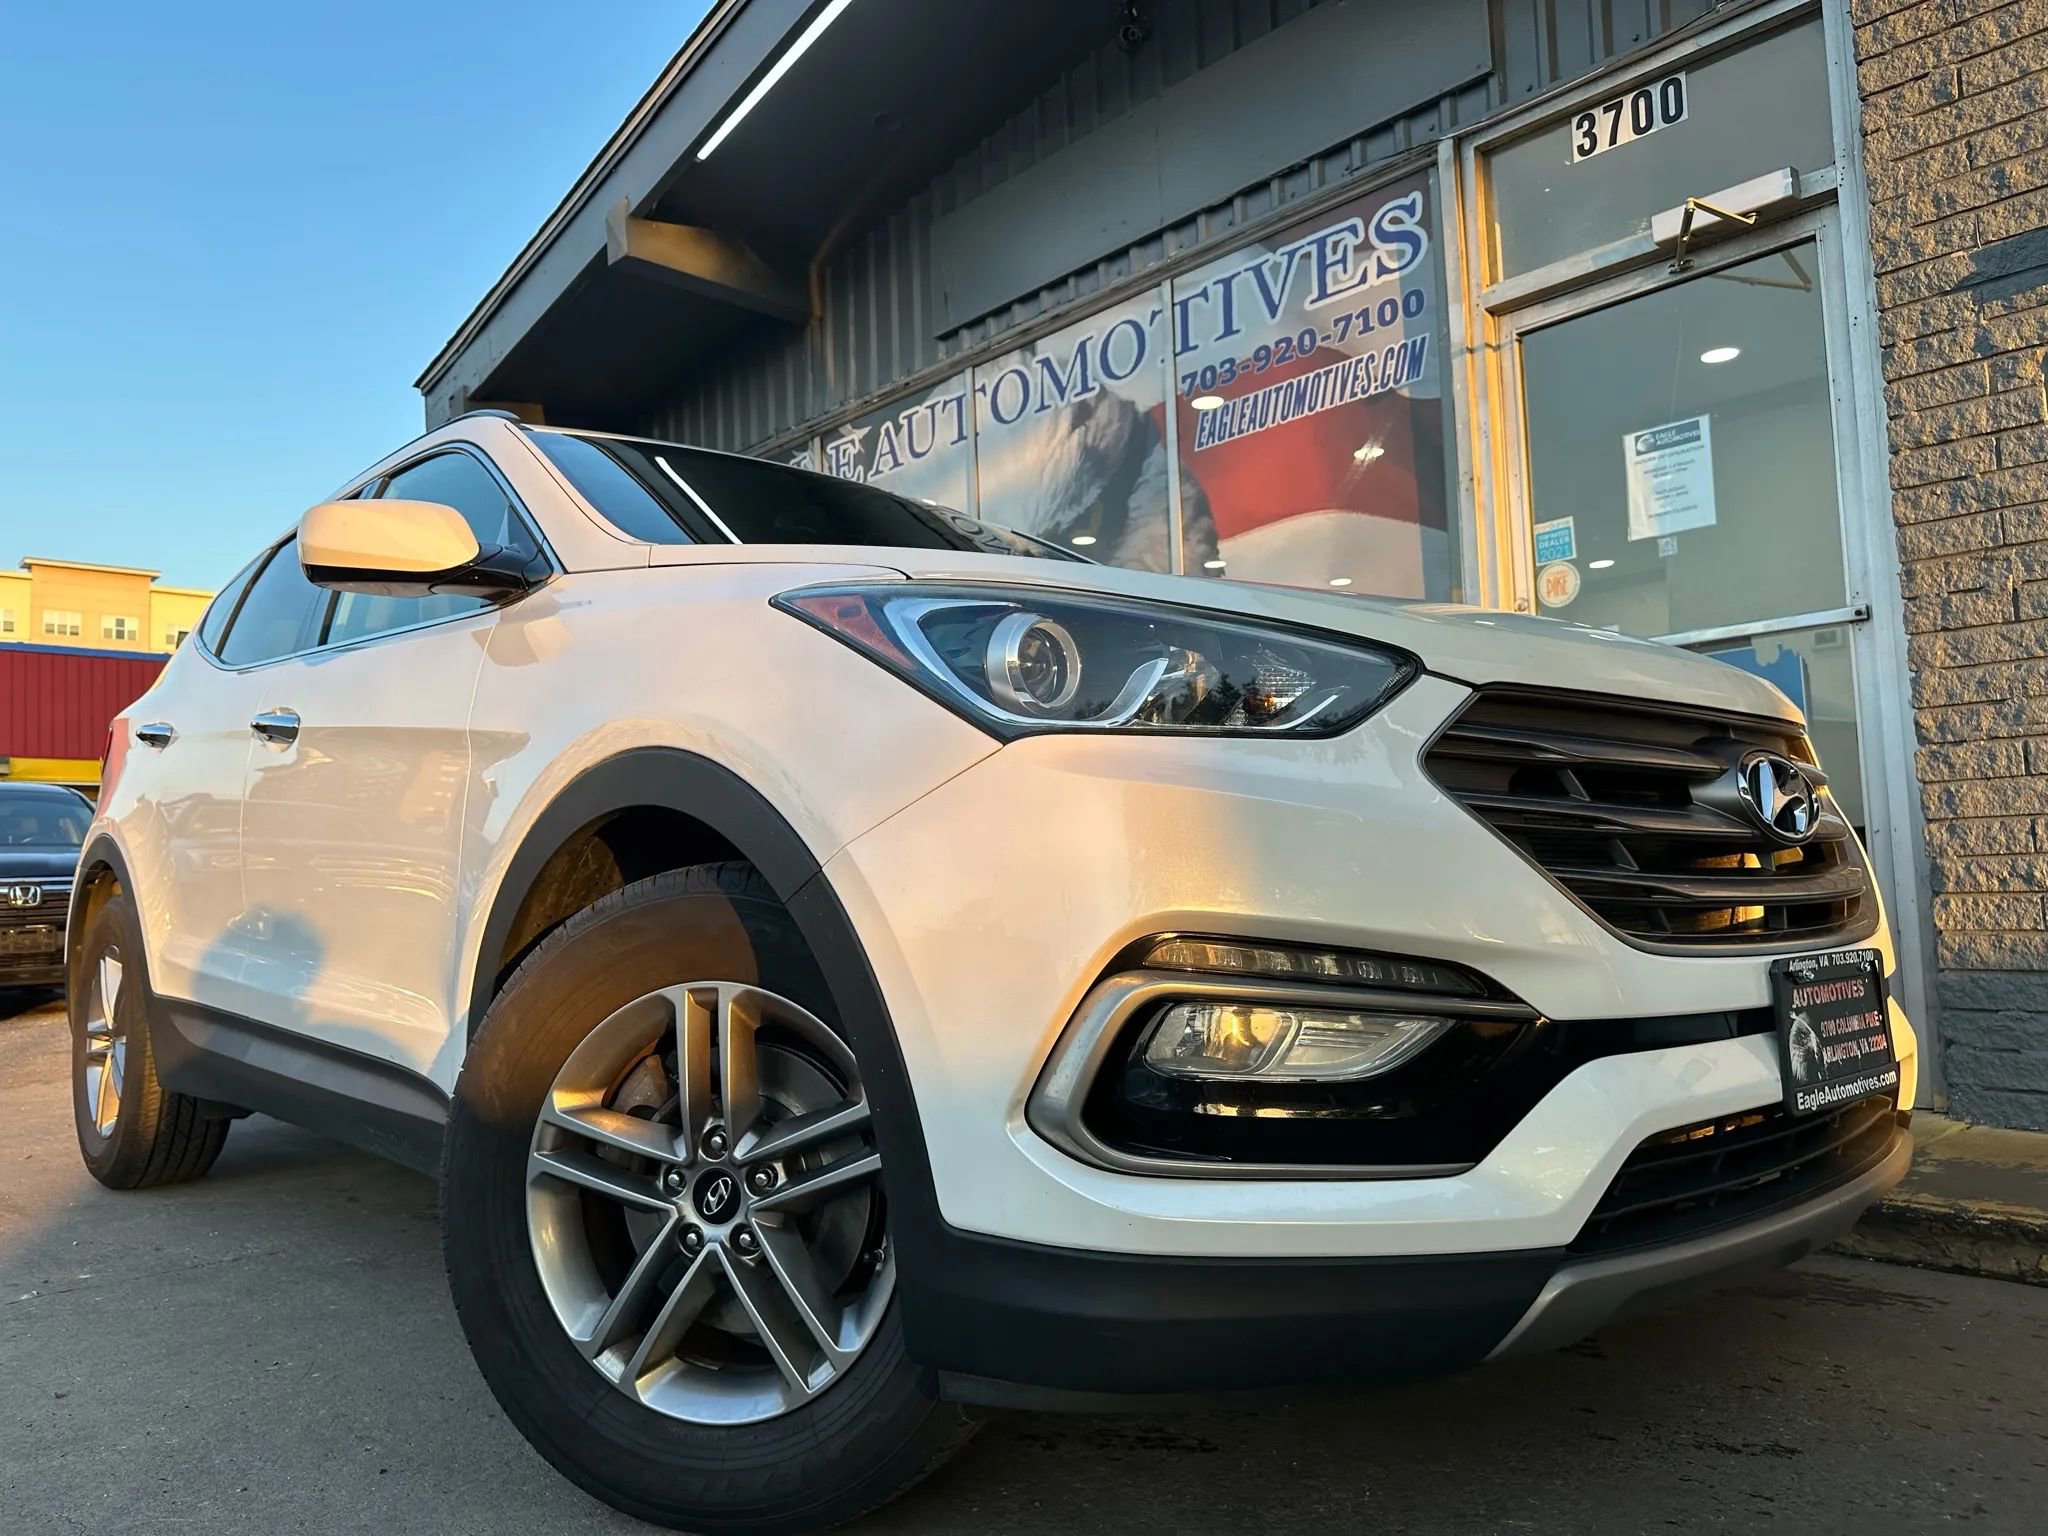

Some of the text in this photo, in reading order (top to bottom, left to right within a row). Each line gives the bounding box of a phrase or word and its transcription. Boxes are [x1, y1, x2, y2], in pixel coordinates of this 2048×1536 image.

[1575, 76, 1685, 158] 3700
[867, 190, 1429, 478] AUTOMOTIVES
[1181, 288, 1426, 399] 703-920-7100
[1195, 333, 1430, 452] EAGLEAUTOMOTIVES.COM
[1655, 429, 1677, 441] EAGLE
[1538, 535, 1570, 549] DEALER
[1540, 545, 1570, 562] 2021
[1546, 575, 1569, 599] PIKE
[1788, 949, 1874, 972] Arlington, VA 703.920.7100
[1792, 979, 1865, 1008] AUTOMOTIVES
[1859, 1038, 1870, 1055] VA
[1796, 1070, 1897, 1111] EagleAutomotives.com
